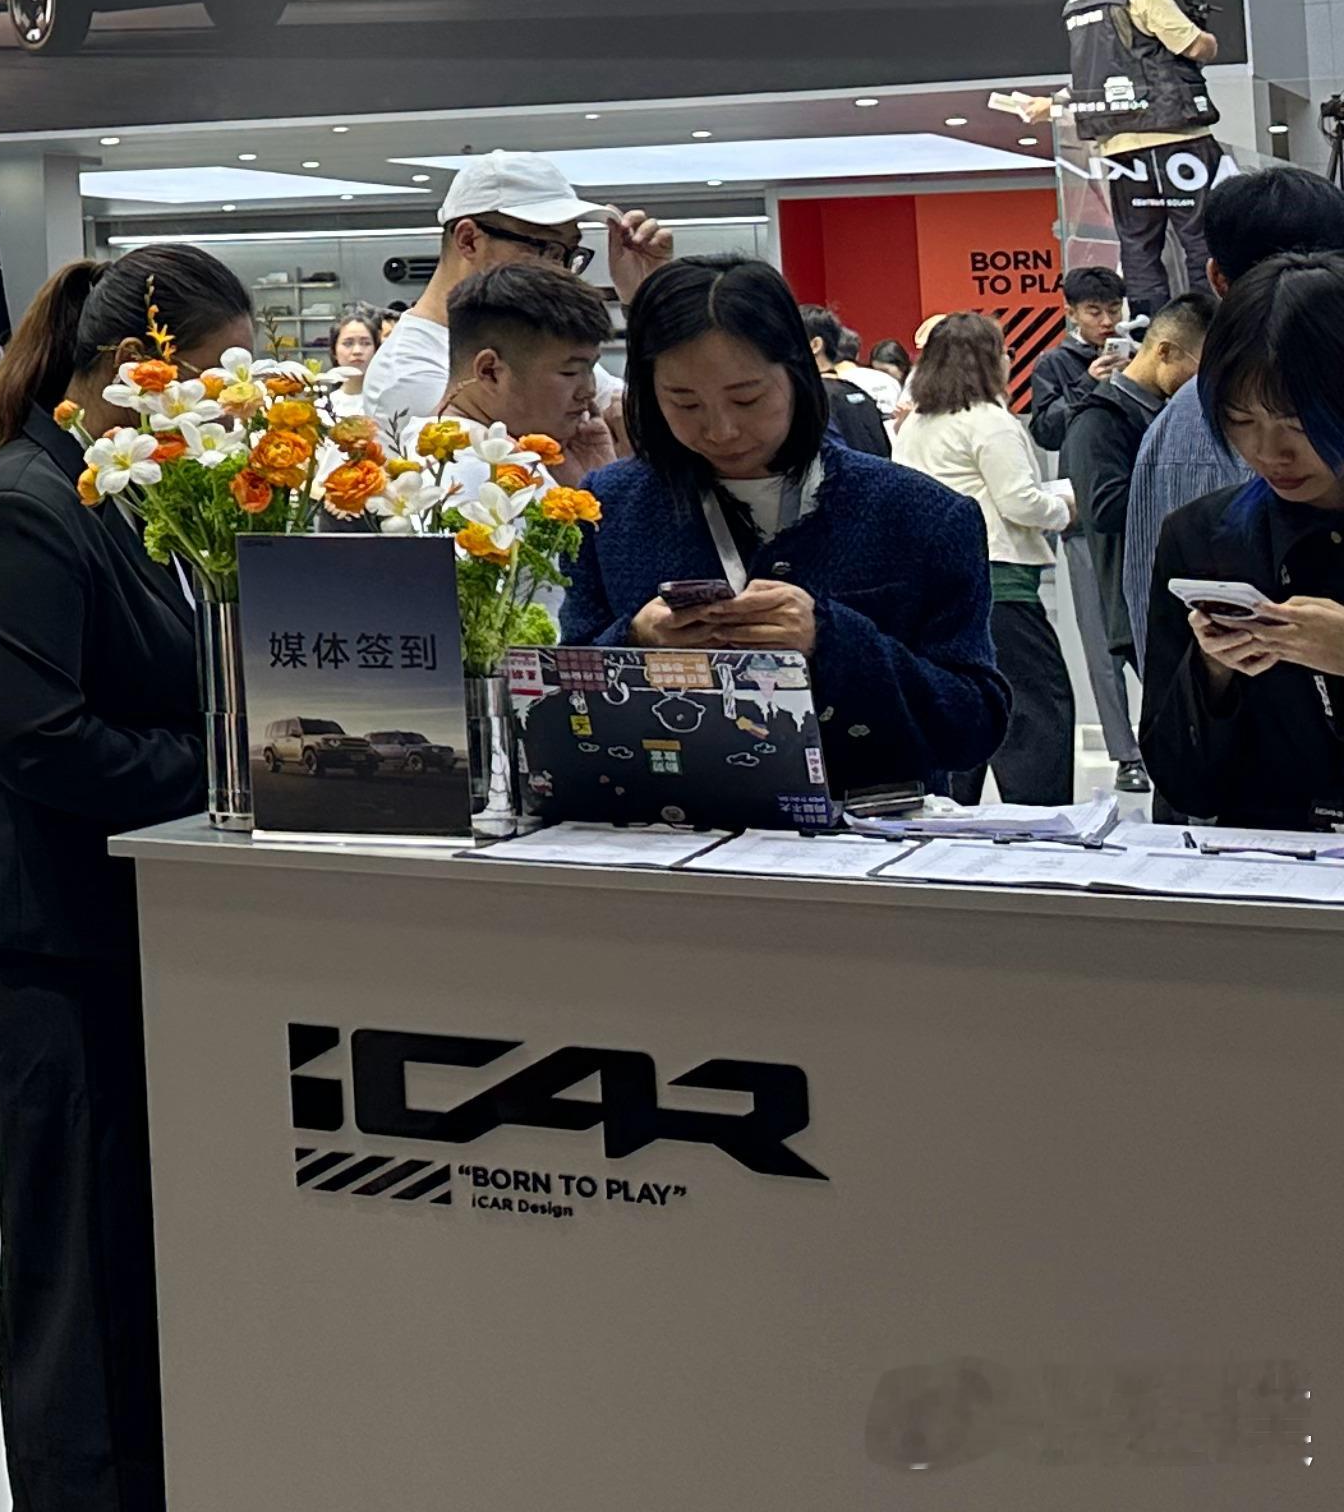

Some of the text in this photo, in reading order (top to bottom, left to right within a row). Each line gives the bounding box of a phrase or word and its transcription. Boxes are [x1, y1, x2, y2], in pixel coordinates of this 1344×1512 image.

[971, 250, 1053, 271] BORN
[973, 273, 1064, 295] TO PLA
[269, 631, 438, 671] 媒体签到
[288, 1022, 831, 1181] iCAR
[559, 1174, 598, 1198] TO
[472, 1194, 574, 1218] iCAR Design
